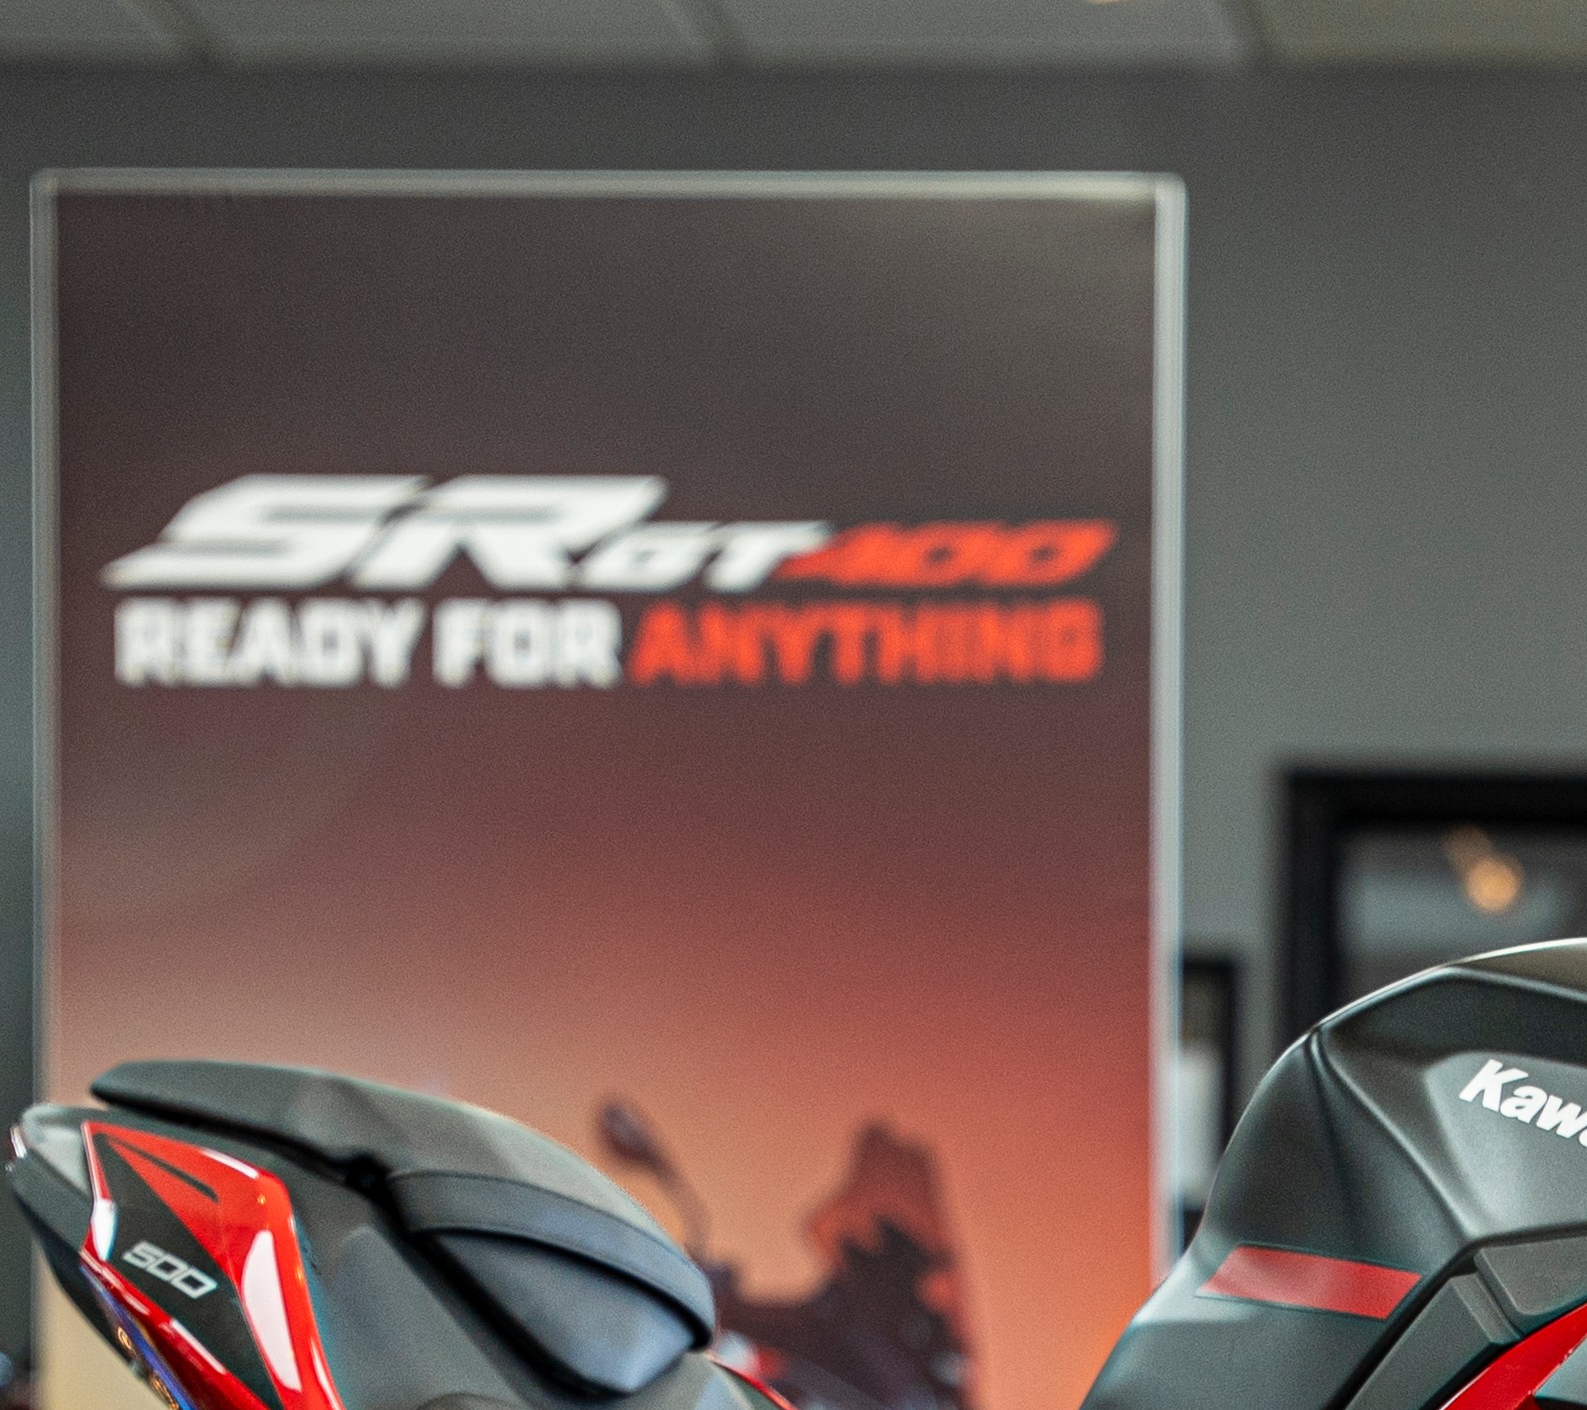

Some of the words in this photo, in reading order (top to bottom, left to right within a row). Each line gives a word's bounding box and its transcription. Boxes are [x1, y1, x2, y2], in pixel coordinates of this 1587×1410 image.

[116, 601, 425, 690] READY
[433, 601, 619, 690] FOR
[629, 601, 1103, 688] ANYTHING
[122, 1241, 218, 1299] 500
